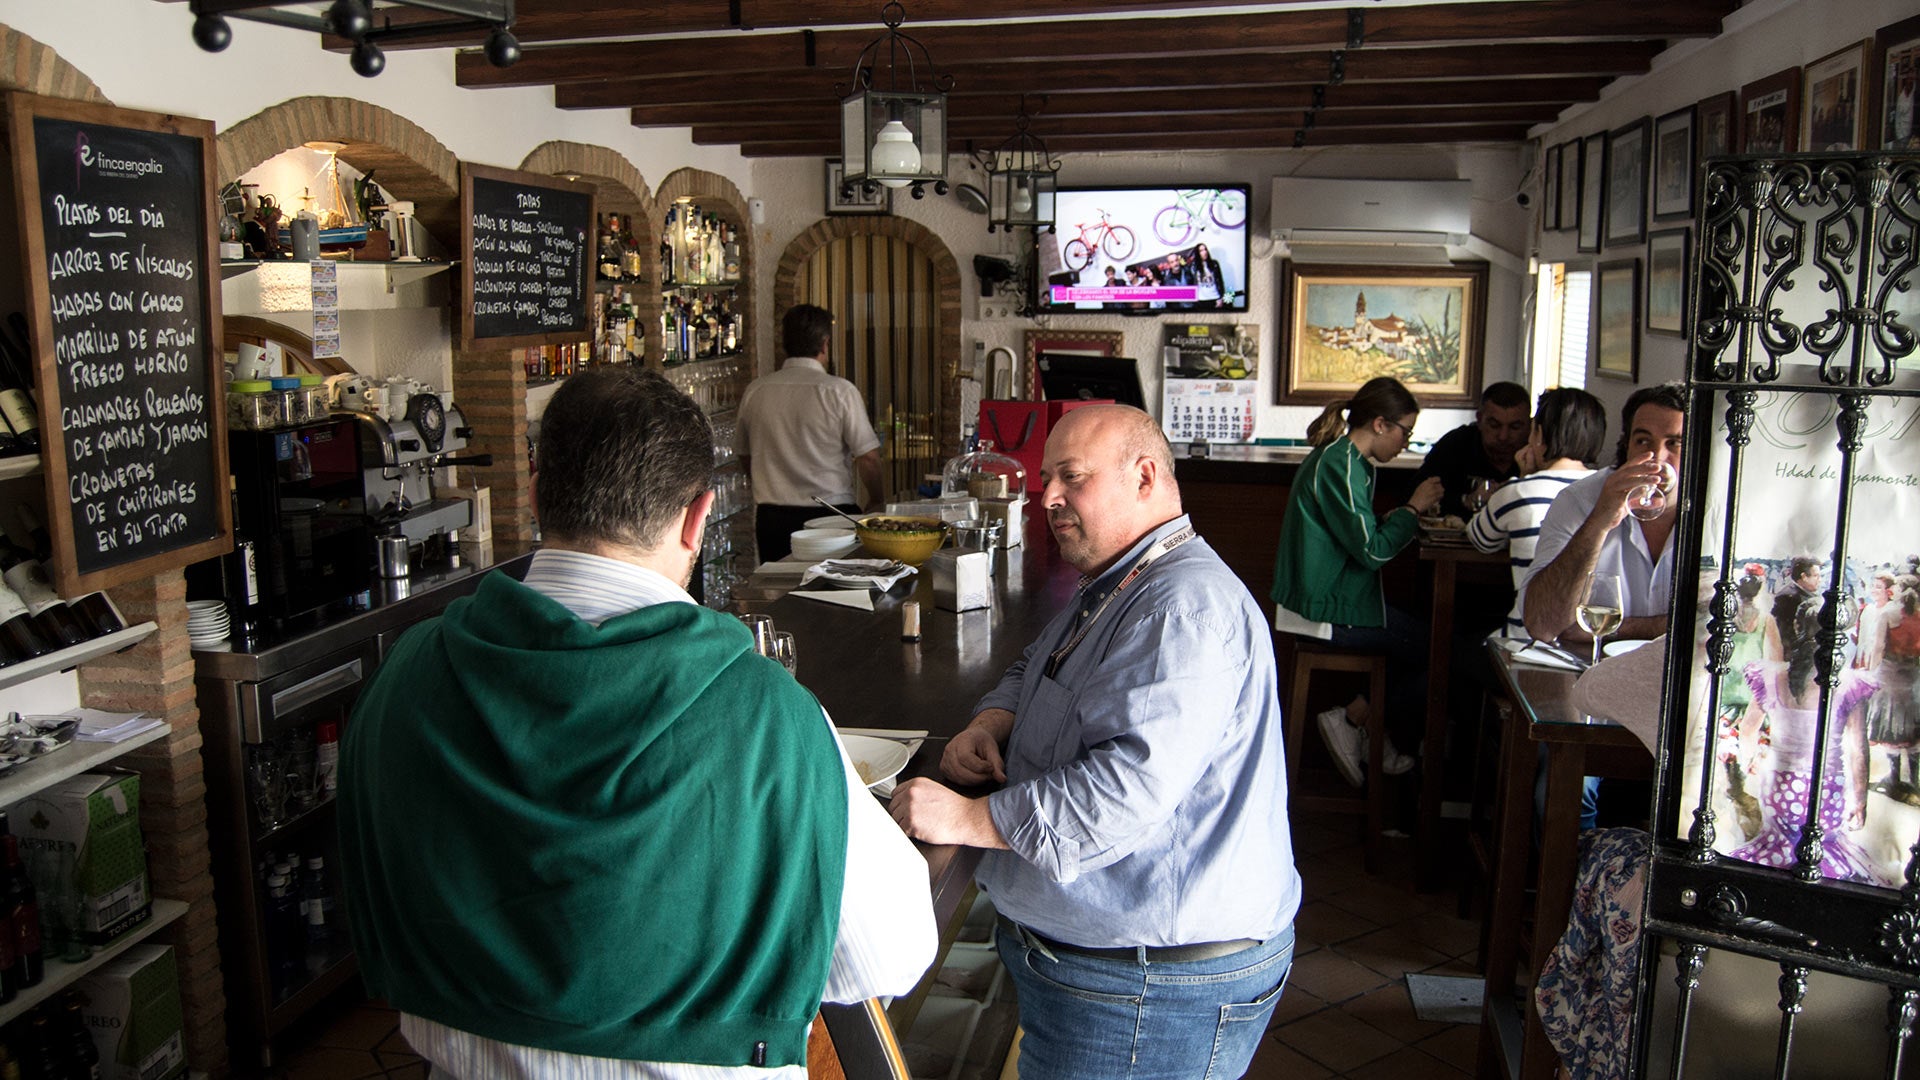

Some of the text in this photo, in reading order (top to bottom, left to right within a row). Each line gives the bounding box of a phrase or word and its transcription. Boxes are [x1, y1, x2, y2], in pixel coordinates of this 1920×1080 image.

[98, 151, 163, 176] fincaengalia
[54, 194, 101, 226] PLATOS
[107, 206, 133, 224] DEL
[516, 193, 541, 209] TAPAS
[472, 214, 532, 233] ARROZ DE PAELLA
[498, 240, 509, 252] AL
[510, 240, 532, 255] HORNO
[545, 236, 553, 247] DE
[51, 243, 193, 281] ARROZ DE NISCALOS
[473, 256, 541, 275] BACALAO DE LA CASA
[563, 255, 571, 267] DE
[51, 290, 184, 324] HABAS CON CHOCO
[473, 300, 540, 320] CROQUETAS GAMBAS
[56, 318, 195, 365] MORRILLO DE ATÚN
[70, 352, 188, 393] FRESCO HORNO
[61, 386, 204, 431] CALAMARES RELLENOS
[73, 436, 93, 461] DE
[150, 421, 166, 450] Y
[163, 418, 208, 455] JAMÓN
[69, 462, 155, 504] CROQUETAS
[1775, 462, 1919, 487] Hdad de yamonte
[86, 479, 197, 525] DE CHIPIRONES
[96, 512, 188, 552] EN SU TINTA
[1163, 533, 1188, 551] SIERRA
